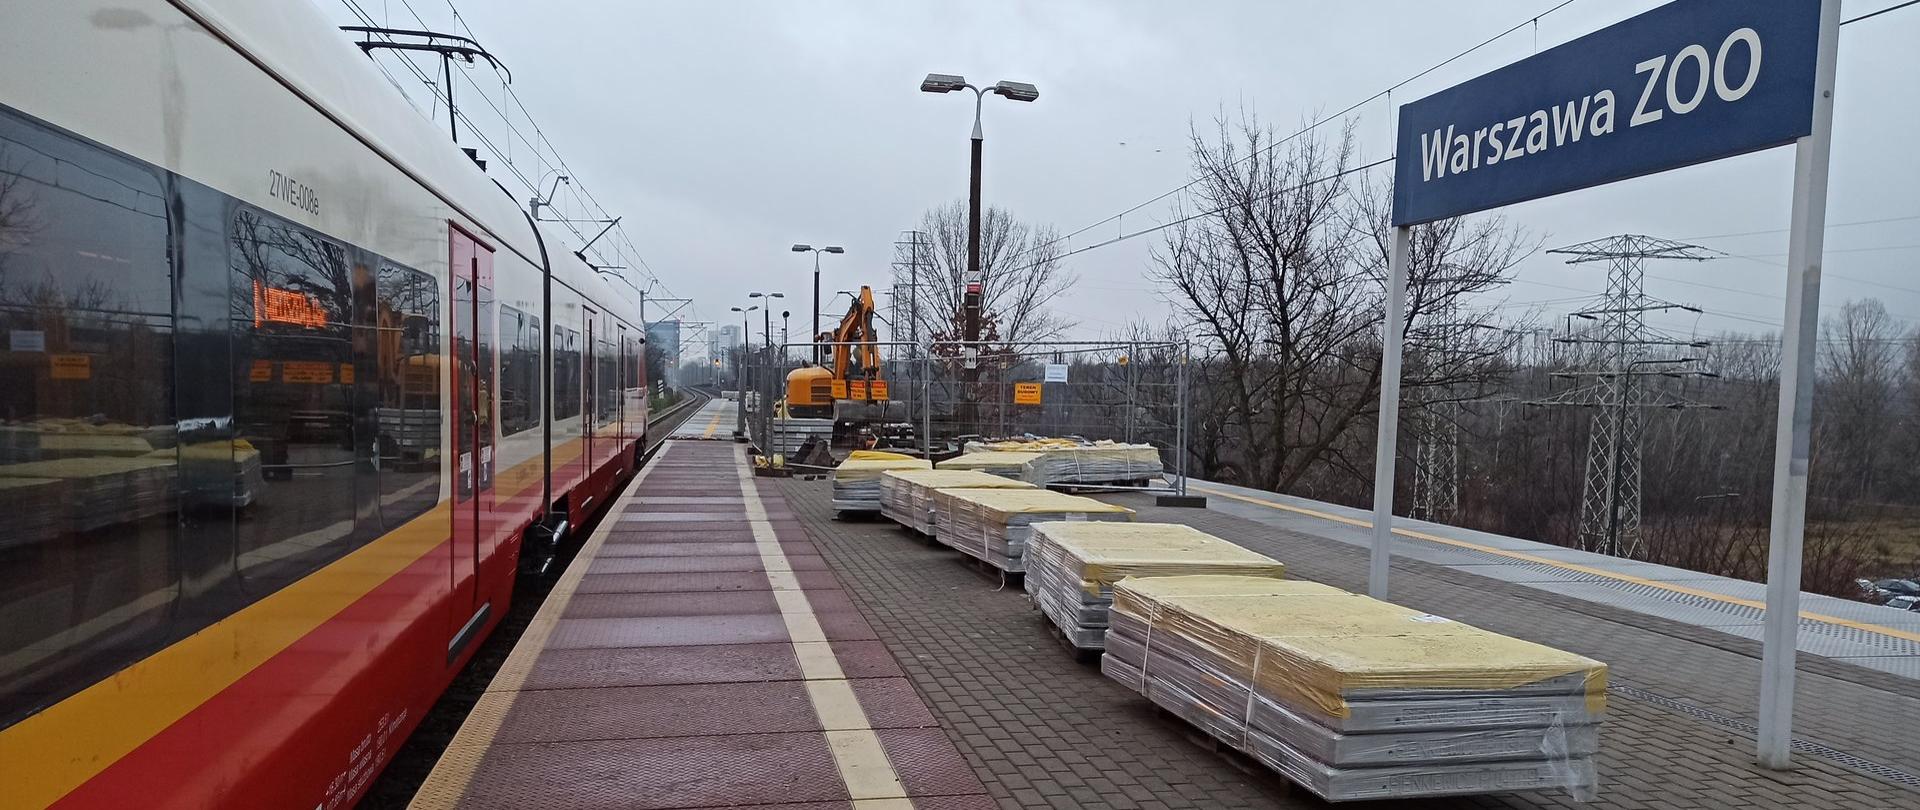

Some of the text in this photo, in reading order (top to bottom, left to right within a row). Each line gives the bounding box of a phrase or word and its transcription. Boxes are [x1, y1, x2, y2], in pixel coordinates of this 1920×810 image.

[1420, 27, 1763, 183] Warszawa ZOO
[269, 168, 319, 217] 27WE-008e
